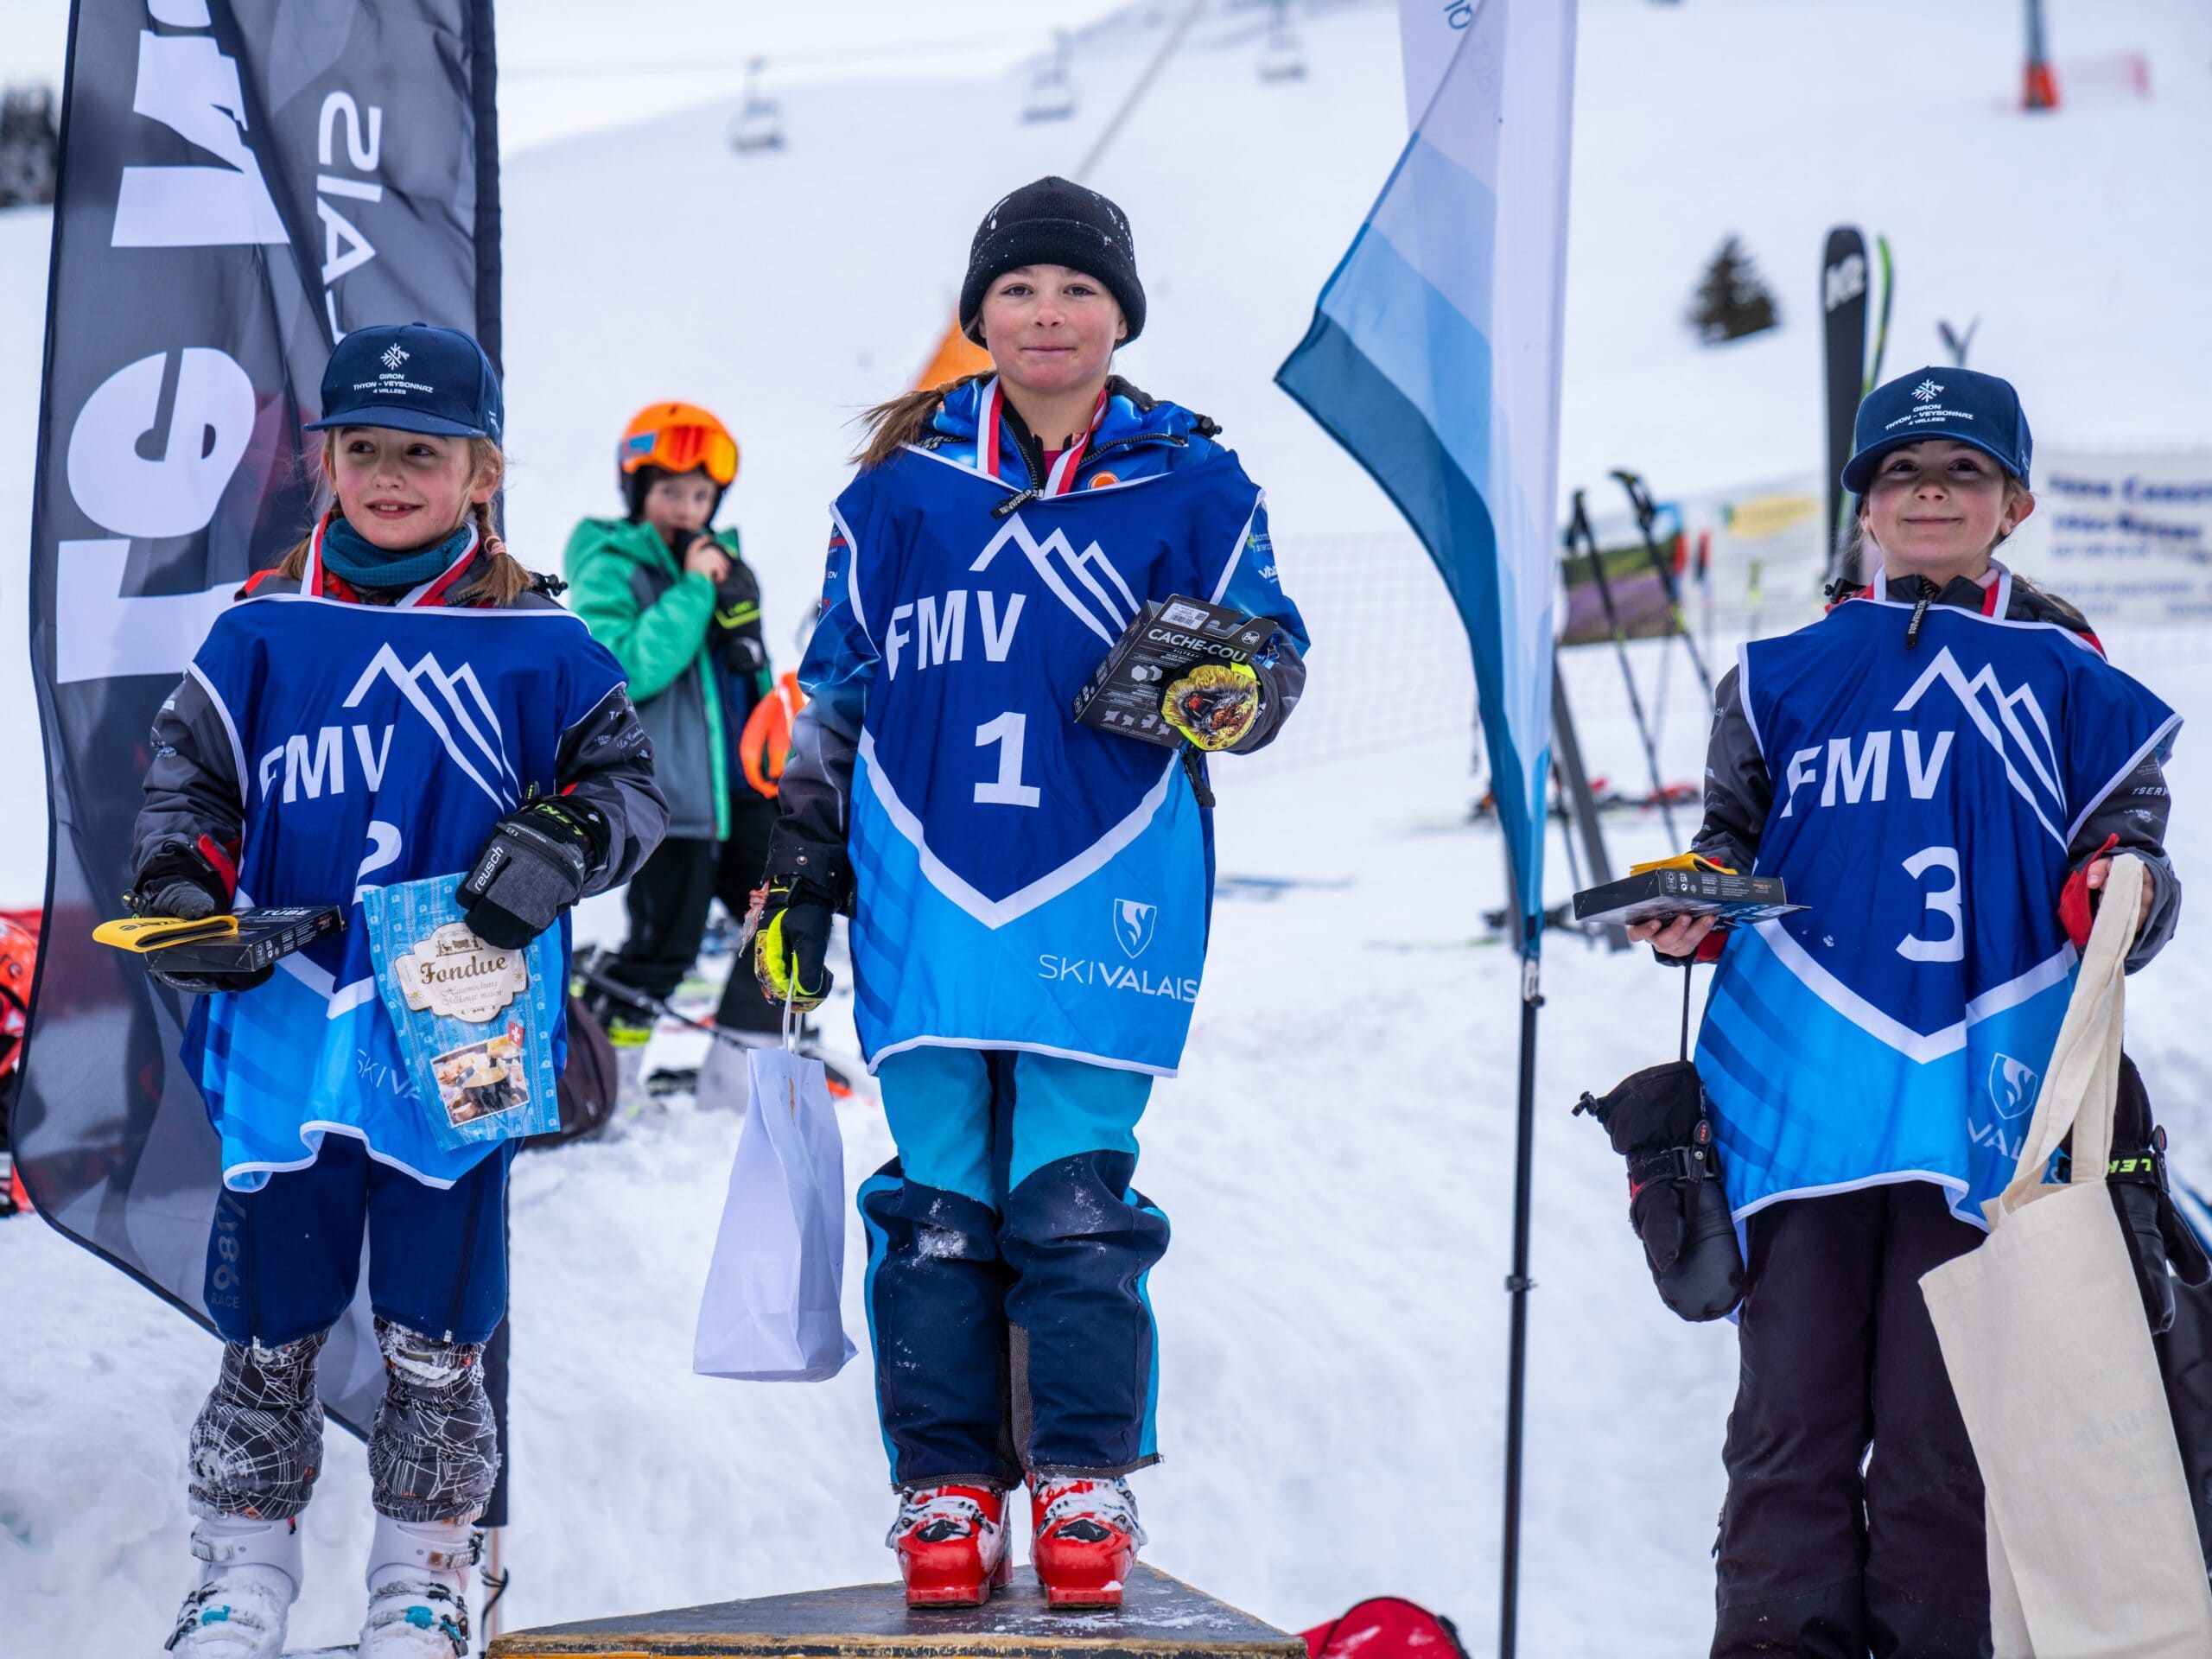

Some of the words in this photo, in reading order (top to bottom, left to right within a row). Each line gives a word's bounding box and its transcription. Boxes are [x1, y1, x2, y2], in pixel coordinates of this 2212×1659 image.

[353, 381, 377, 391] THYON
[383, 381, 434, 393] VEYSONNAZ
[1913, 404, 1942, 413] GIRON
[1885, 415, 1911, 430] THYON
[1918, 410, 1974, 421] VEYSONNAZ
[887, 589, 1027, 682] FMV
[1147, 628, 1248, 663] CACHE-COU
[260, 724, 395, 804] FMV
[973, 711, 1040, 809] 1
[1780, 728, 1955, 818] FMV
[352, 820, 402, 906] 2
[474, 845, 504, 892] reusch
[1897, 846, 1965, 963] 3
[420, 955, 508, 986] Fondue
[211, 1293, 240, 1309] RACE
